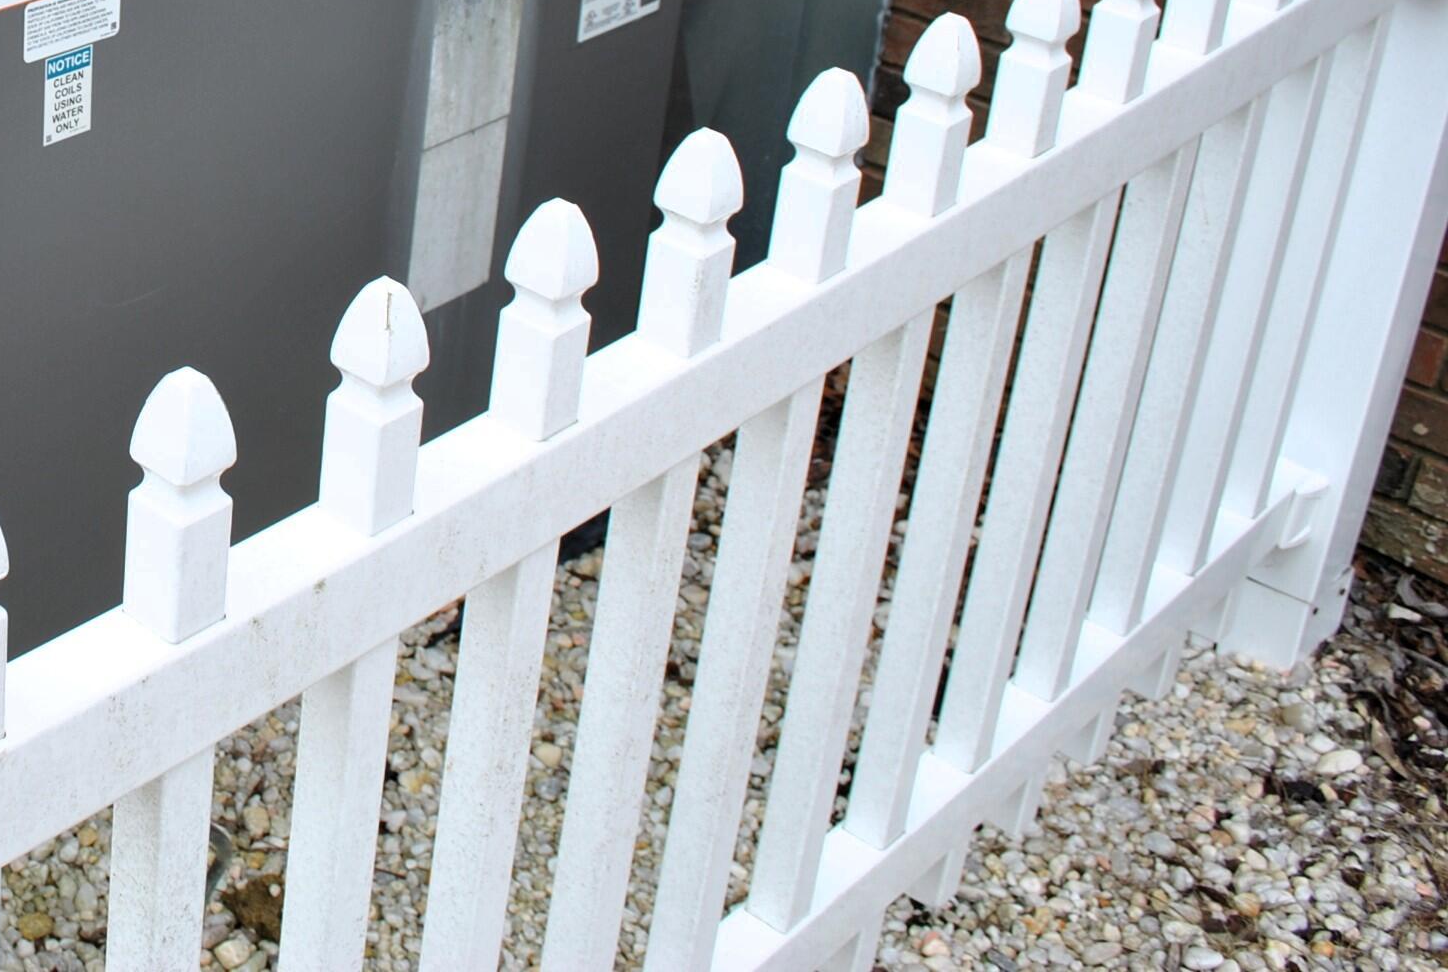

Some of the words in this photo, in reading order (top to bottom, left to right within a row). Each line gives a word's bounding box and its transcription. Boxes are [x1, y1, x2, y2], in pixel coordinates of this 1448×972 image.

[48, 50, 90, 75] NOTICE
[53, 70, 84, 88] CLEAN
[55, 83, 82, 100] COILS
[54, 94, 82, 112] USING
[52, 105, 84, 123] WATER
[56, 118, 80, 134] ONLY
